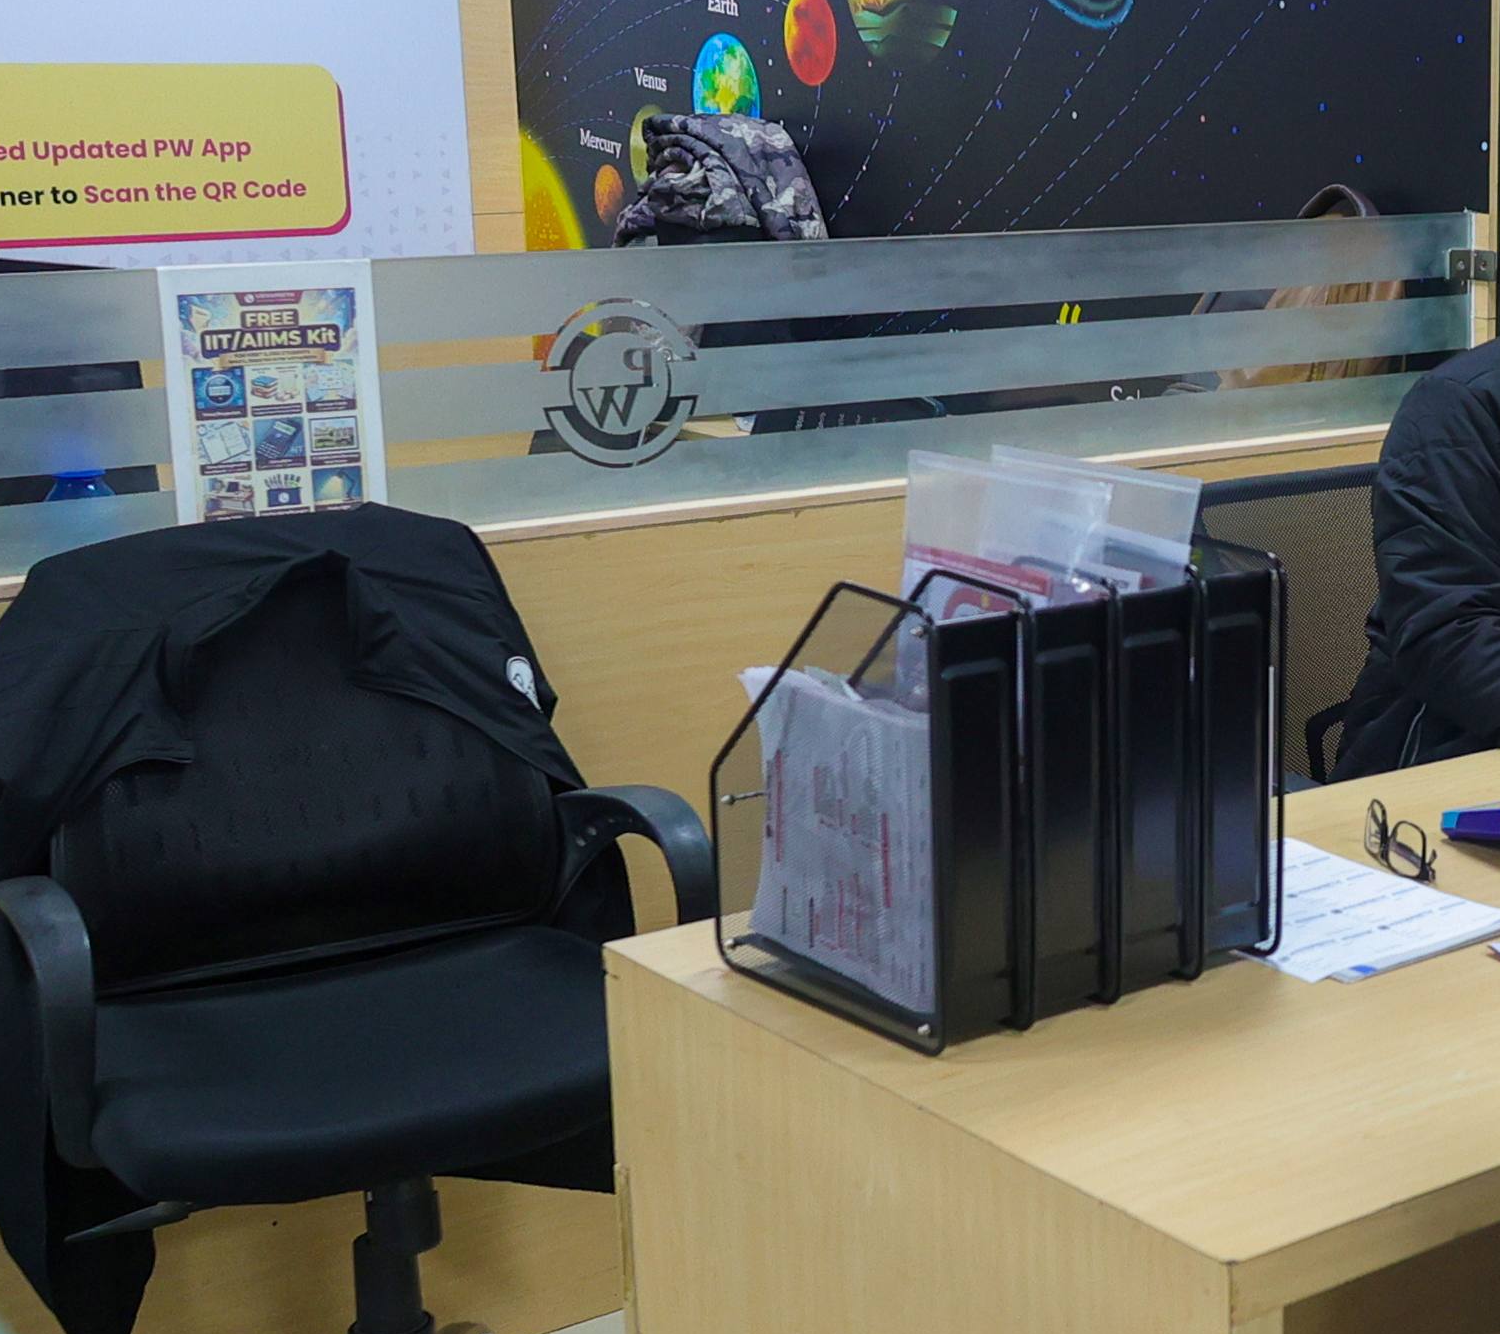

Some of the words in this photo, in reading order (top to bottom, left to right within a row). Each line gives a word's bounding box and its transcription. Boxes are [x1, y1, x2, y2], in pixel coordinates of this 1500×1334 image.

[634, 67, 667, 92] Venus
[32, 138, 148, 167] Updated
[153, 138, 195, 158] PW
[201, 138, 252, 163] App
[580, 128, 622, 159] Mercury
[49, 185, 79, 205] to
[83, 184, 150, 205] Scan
[154, 181, 198, 202] the
[202, 181, 238, 203] QR
[242, 178, 308, 200] Code
[245, 311, 294, 326] FREE
[204, 331, 301, 350] IIT/AIIMS
[307, 327, 337, 344] Kit
